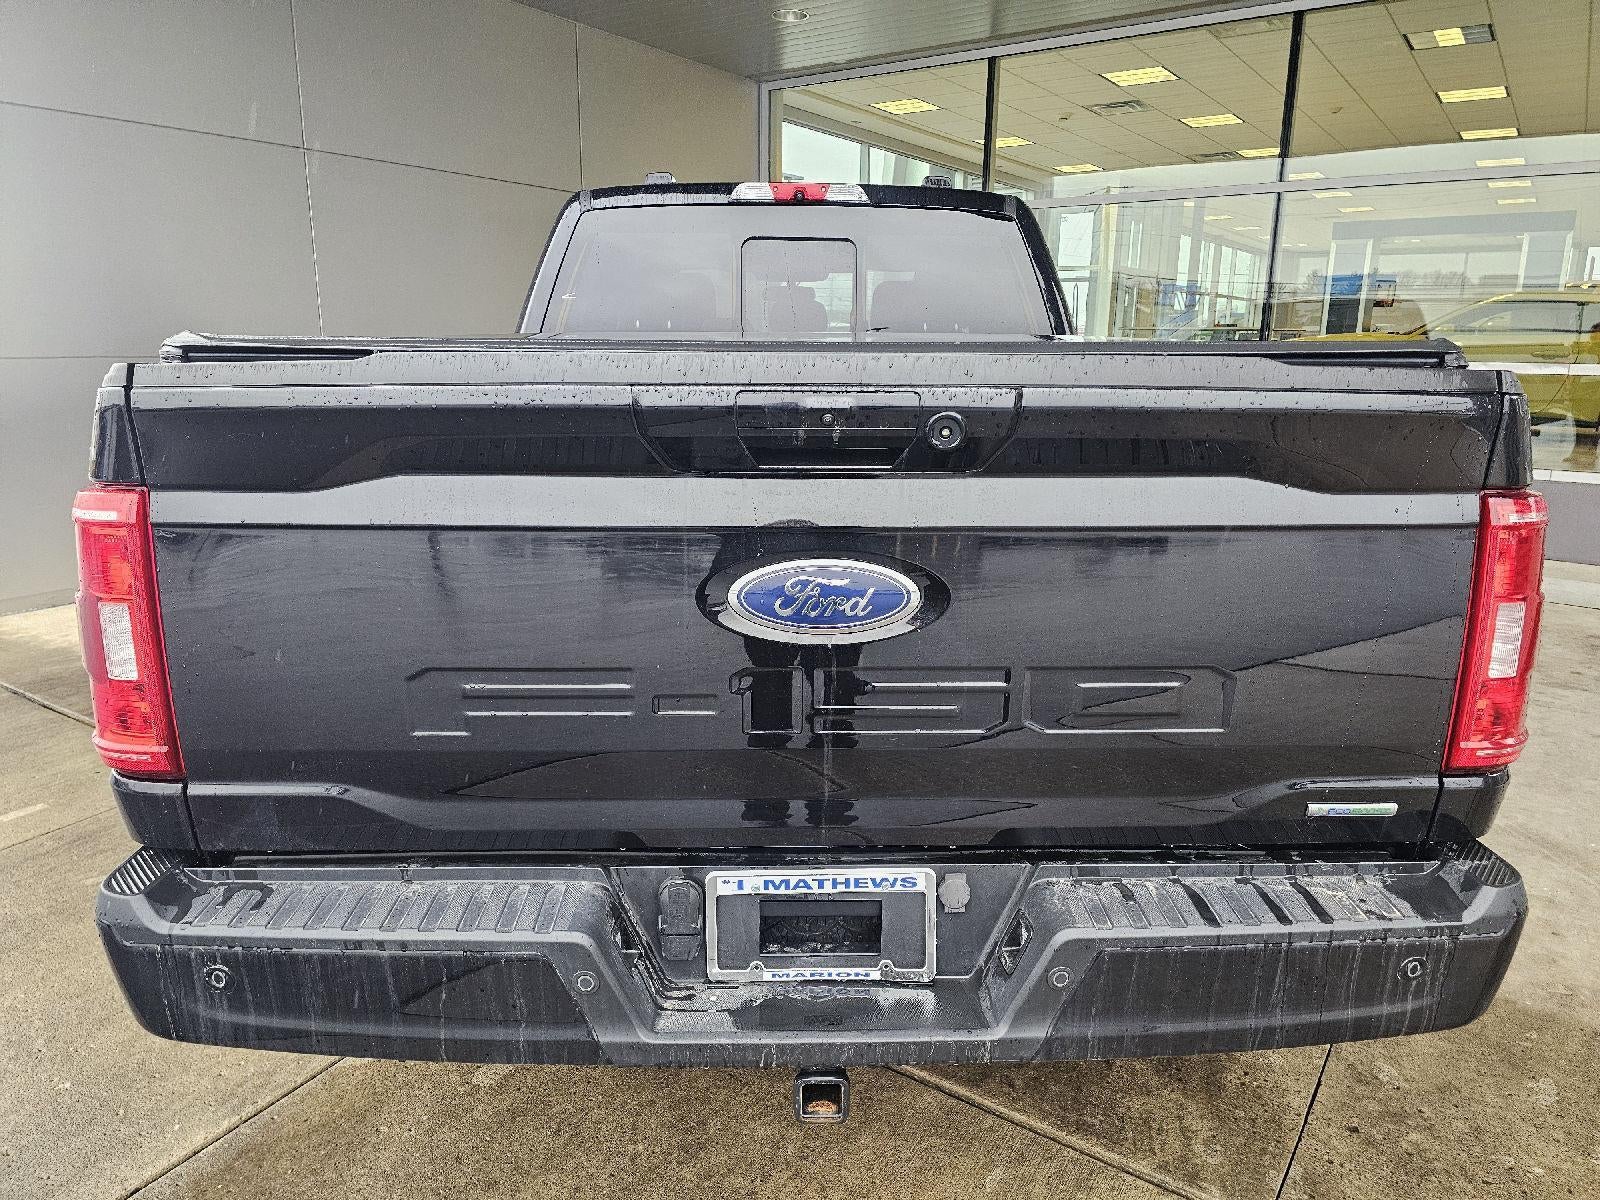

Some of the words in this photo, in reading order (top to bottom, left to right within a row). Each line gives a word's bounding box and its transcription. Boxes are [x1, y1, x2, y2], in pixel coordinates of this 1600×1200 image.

[774, 575, 875, 618] Ford
[405, 666, 1238, 736] F-150
[762, 876, 919, 891] MATHEWS
[771, 971, 871, 979] MARION
